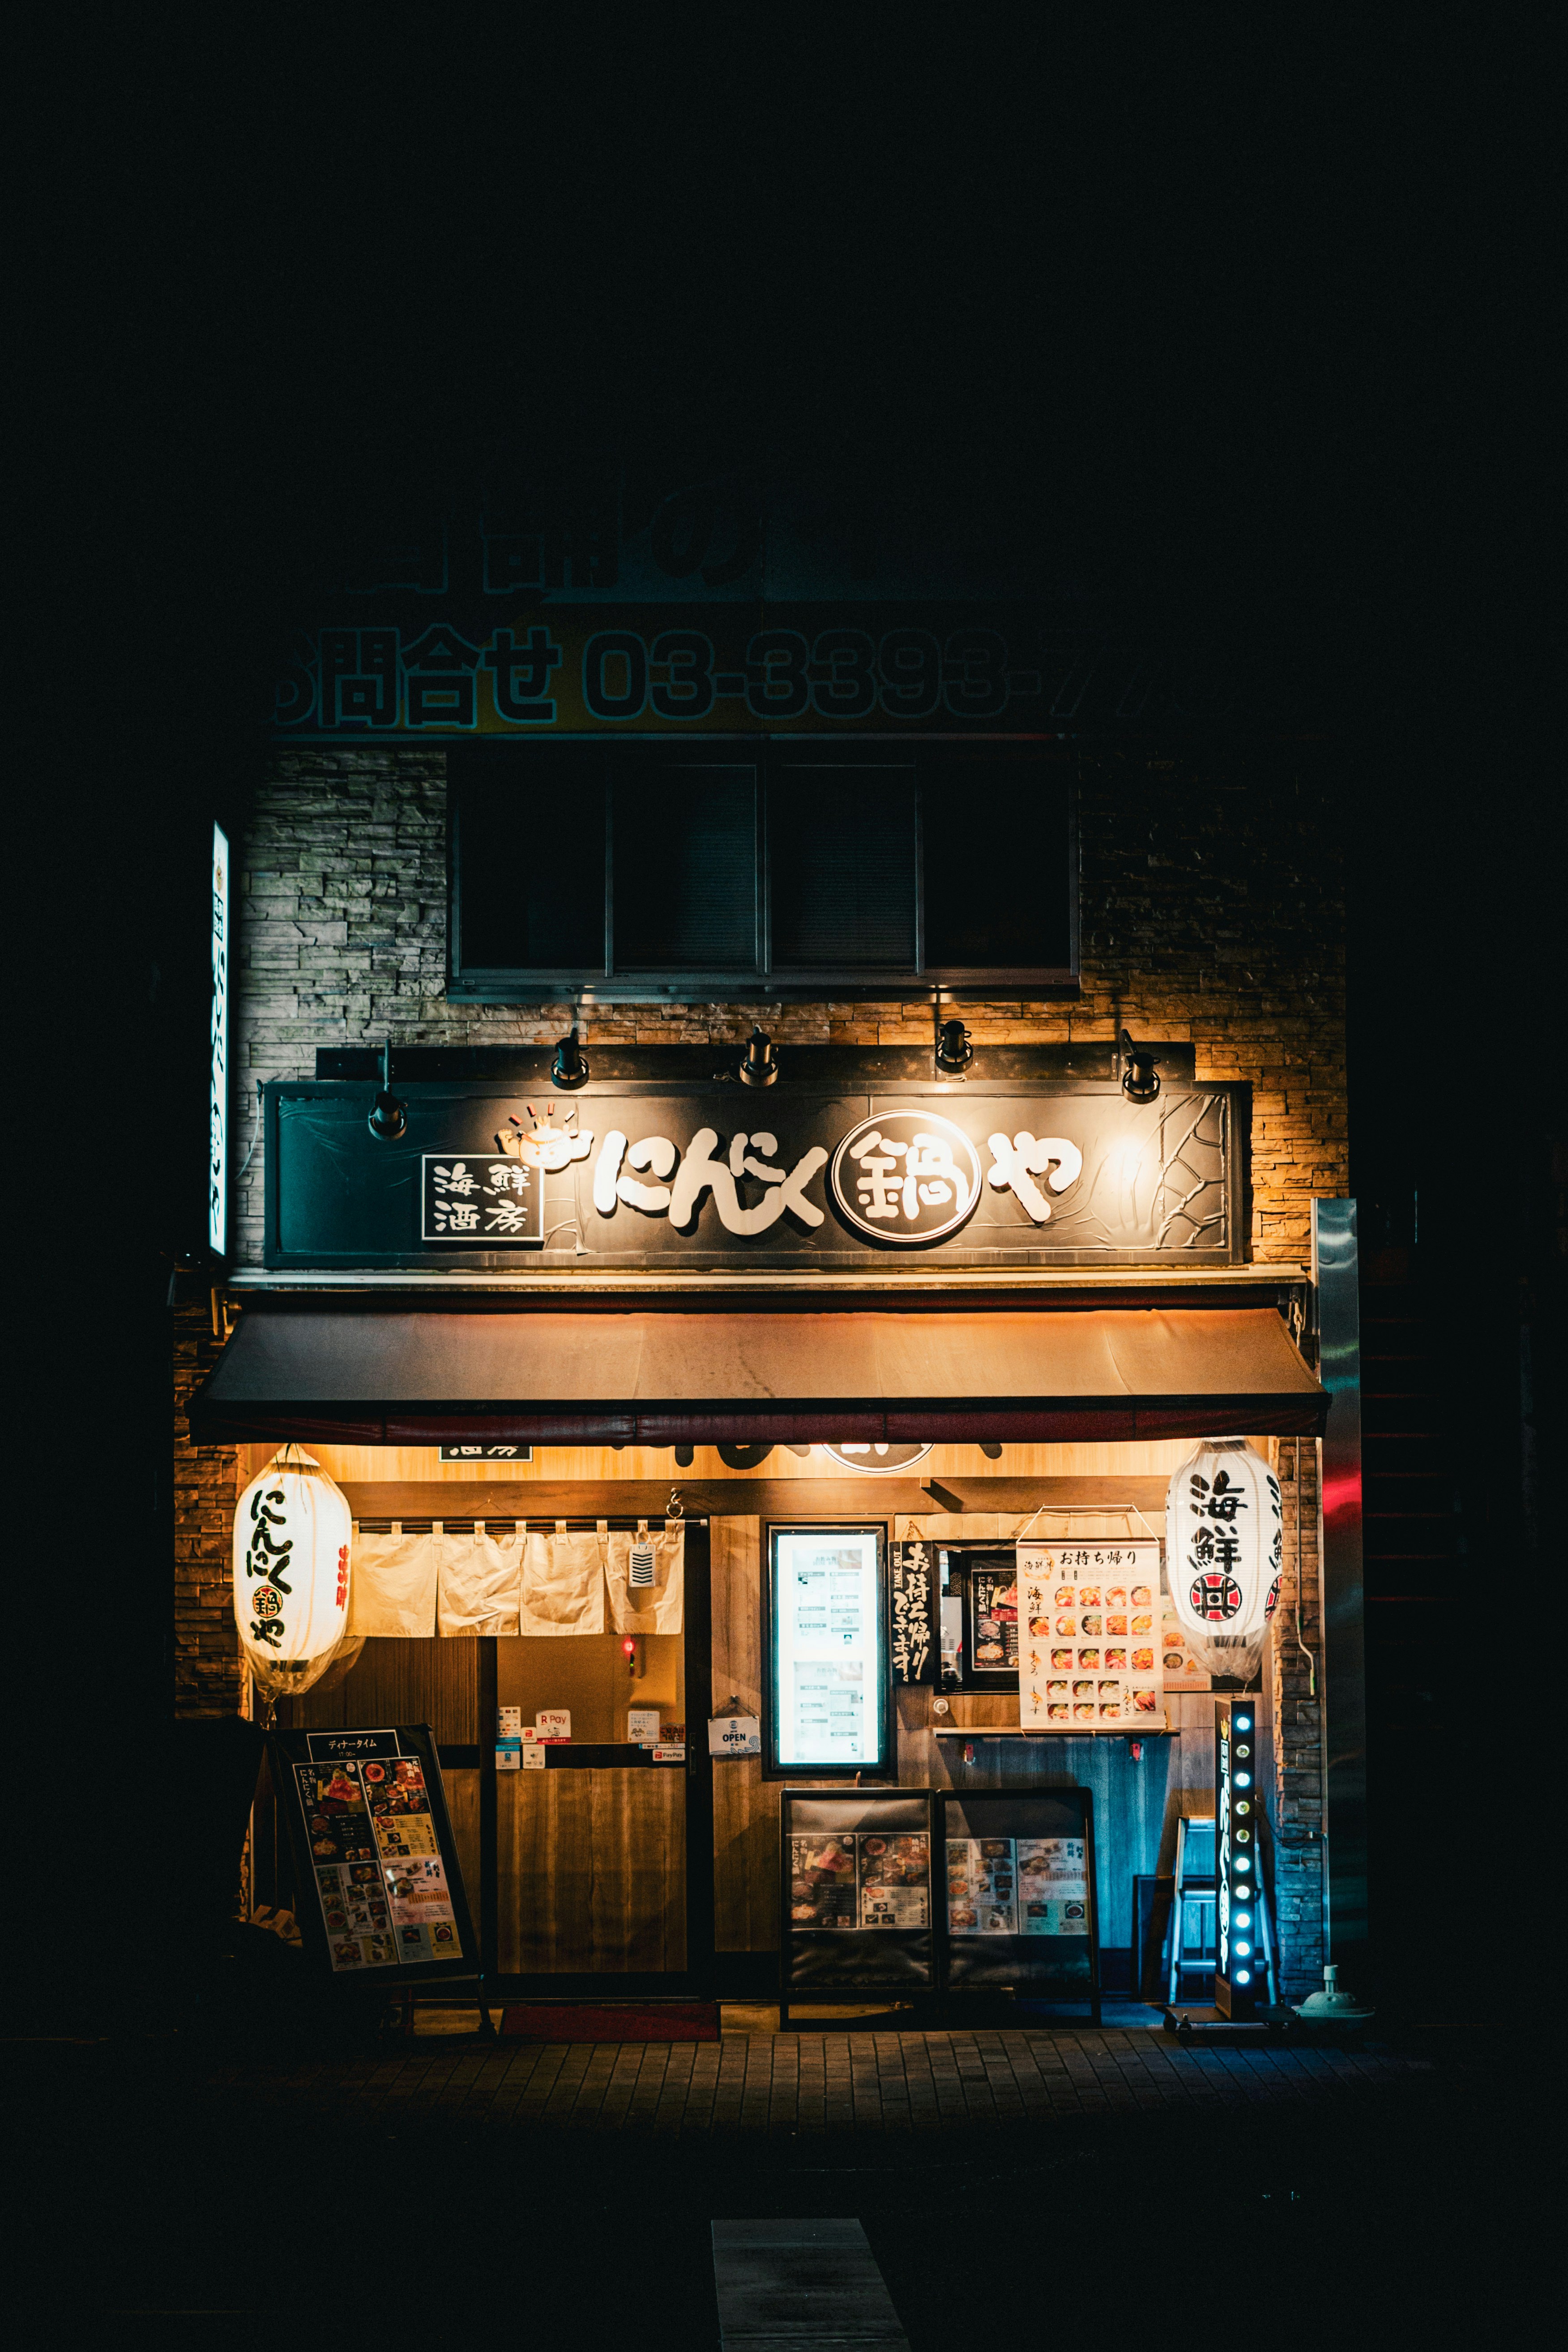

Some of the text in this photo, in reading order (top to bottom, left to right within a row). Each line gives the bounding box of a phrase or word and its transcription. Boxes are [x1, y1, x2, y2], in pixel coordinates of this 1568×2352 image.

[433, 1163, 531, 1196] 海鮮
[594, 1126, 1083, 1236] にんにく鍋や
[433, 1198, 529, 1234] 酒房
[1187, 1470, 1248, 1574] 海鮮
[246, 1489, 293, 1648] にんにく鍋や
[1060, 1550, 1136, 1565] お持ち帰り
[902, 1542, 930, 1681] お持ち帰り
[1027, 1586, 1043, 1614] 海鮮
[1030, 1685, 1040, 1715] しらす
[1123, 1685, 1132, 1715] うなぎ
[541, 1715, 567, 1725] R Pay
[328, 1738, 377, 1750] ディナータイム
[722, 1733, 746, 1742] OPEN
